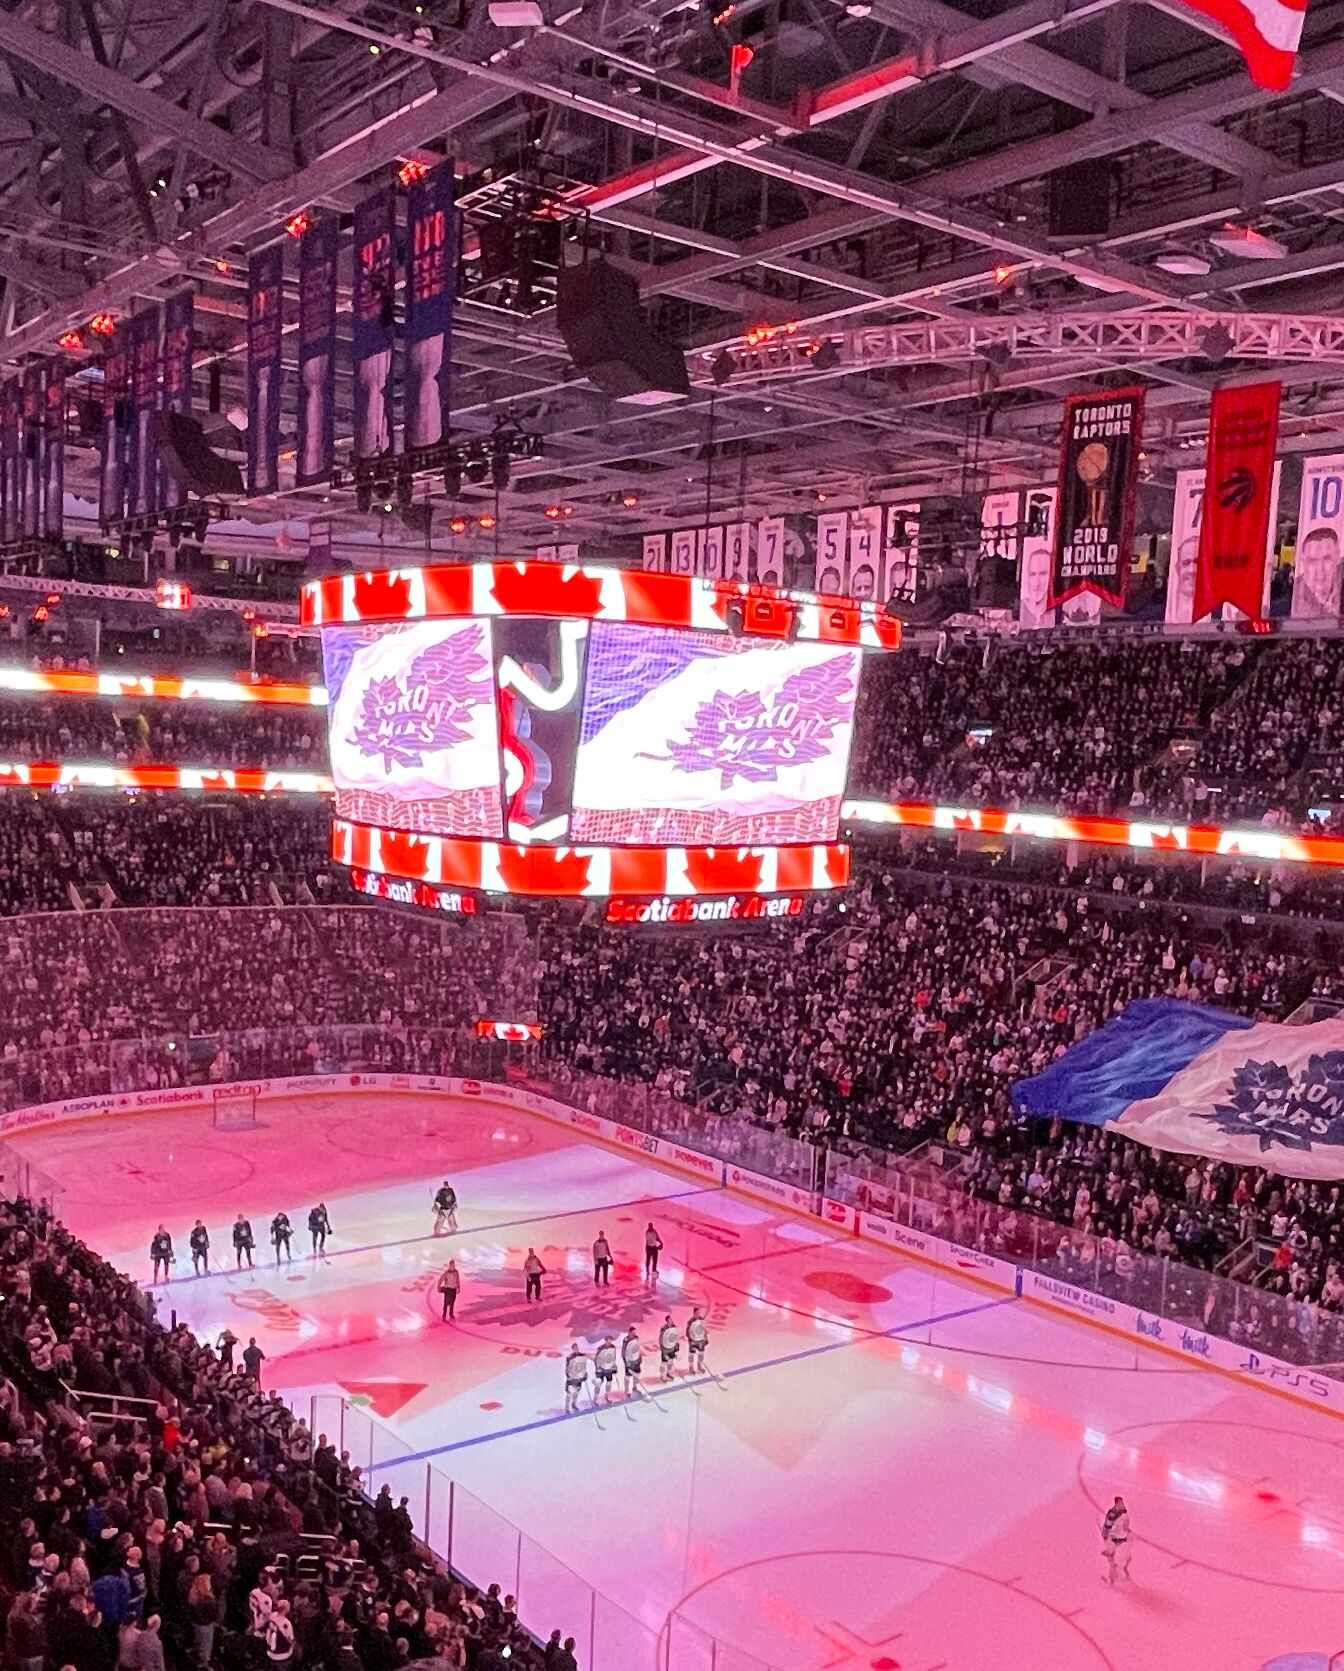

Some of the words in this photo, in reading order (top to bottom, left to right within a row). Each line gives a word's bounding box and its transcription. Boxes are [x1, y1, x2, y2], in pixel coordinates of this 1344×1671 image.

[1074, 403, 1132, 423] TORONTO
[1073, 420, 1131, 440] RAPTORS
[1311, 476, 1344, 520] 10
[825, 528, 838, 560] 5
[859, 535, 872, 558] 4
[1073, 527, 1109, 544] 2019
[675, 544, 691, 572] 13
[766, 534, 777, 564] 7
[1063, 544, 1119, 565] WORLD
[421, 884, 477, 915] Arena
[606, 896, 740, 923] Scotiabank
[743, 896, 803, 918] Arena
[363, 1076, 377, 1085] LG
[136, 1090, 204, 1106] Scotiabank
[1082, 1293, 1116, 1314] CASINO
[1269, 1363, 1329, 1398] PS5
